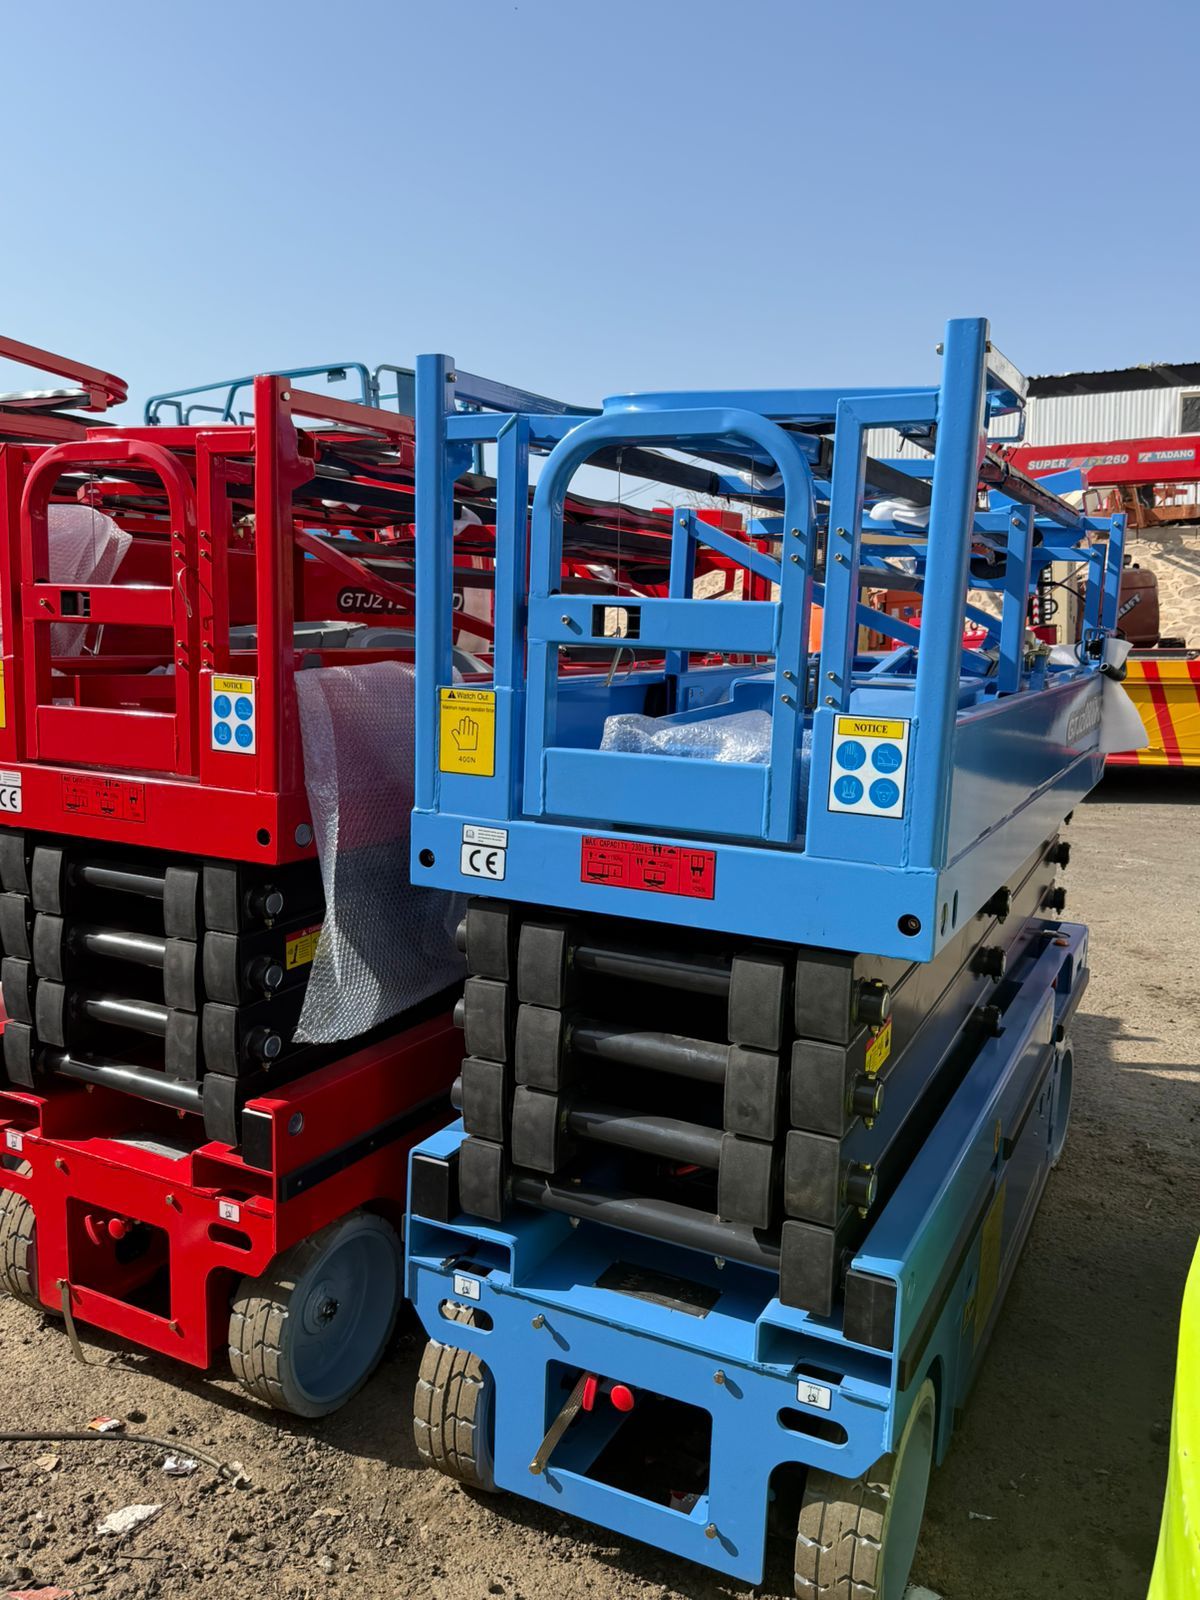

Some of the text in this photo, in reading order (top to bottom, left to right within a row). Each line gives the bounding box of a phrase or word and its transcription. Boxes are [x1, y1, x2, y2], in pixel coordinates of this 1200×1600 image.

[1155, 449, 1194, 459] TADANO
[1027, 458, 1067, 470] SUPER
[222, 681, 243, 690] NOTICE
[457, 691, 489, 701] Watch Out
[853, 723, 888, 734] NOTICE
[0, 788, 17, 809] CE
[599, 839, 627, 850] CAPACITY
[469, 849, 498, 875] CE
